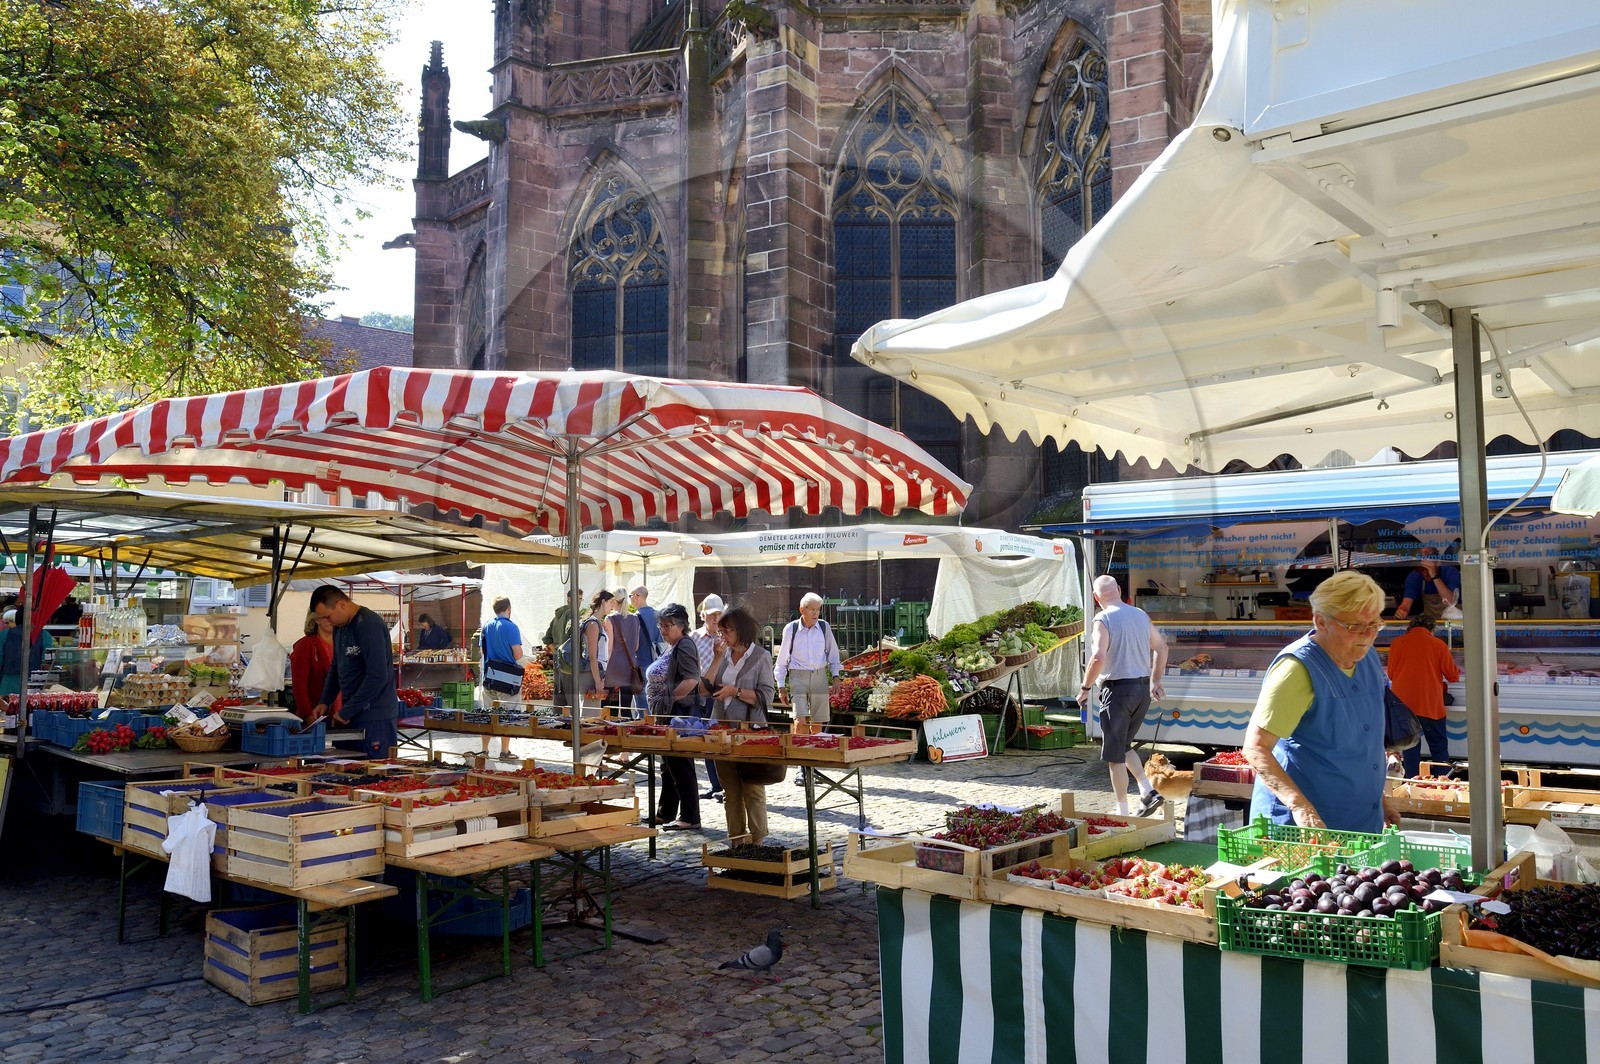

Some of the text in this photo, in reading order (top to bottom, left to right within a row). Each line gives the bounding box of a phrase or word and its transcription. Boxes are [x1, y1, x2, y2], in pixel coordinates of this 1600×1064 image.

[1377, 528, 1394, 537] Wir
[1528, 521, 1553, 532] geht
[1555, 519, 1587, 529] nicht!
[1249, 533, 1268, 543] geht
[1271, 532, 1296, 541] nicht!
[1523, 535, 1589, 545] Schlachtung
[758, 541, 836, 553] gemüse mit charakter
[1245, 545, 1297, 555] Schlachtung
[1518, 549, 1542, 558] dem
[931, 722, 967, 747] piluweri
